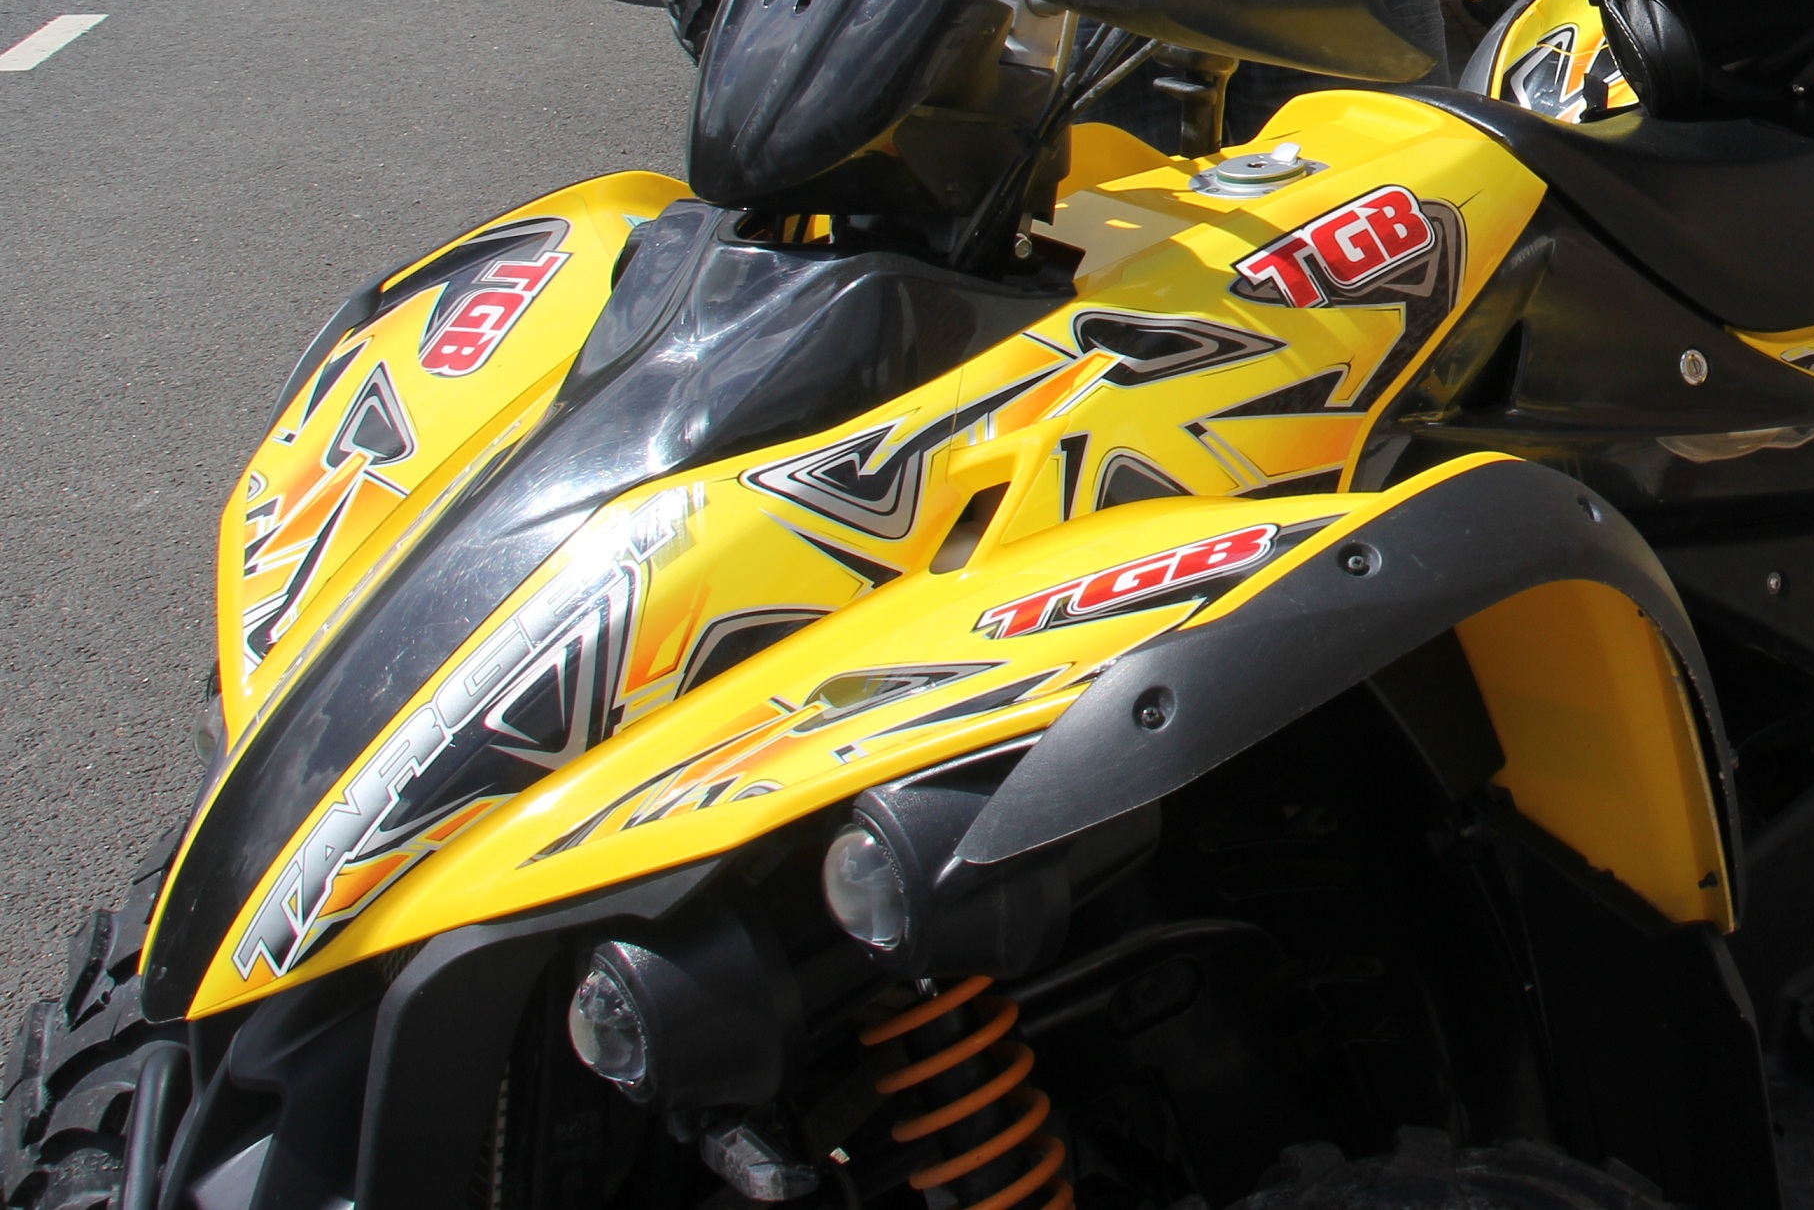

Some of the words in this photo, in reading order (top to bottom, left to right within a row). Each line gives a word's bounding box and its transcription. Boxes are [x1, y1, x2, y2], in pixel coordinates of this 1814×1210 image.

[1231, 184, 1434, 309] TGB
[418, 252, 571, 377] TGB
[972, 525, 1280, 640] TGB
[212, 482, 692, 983] TARGET
